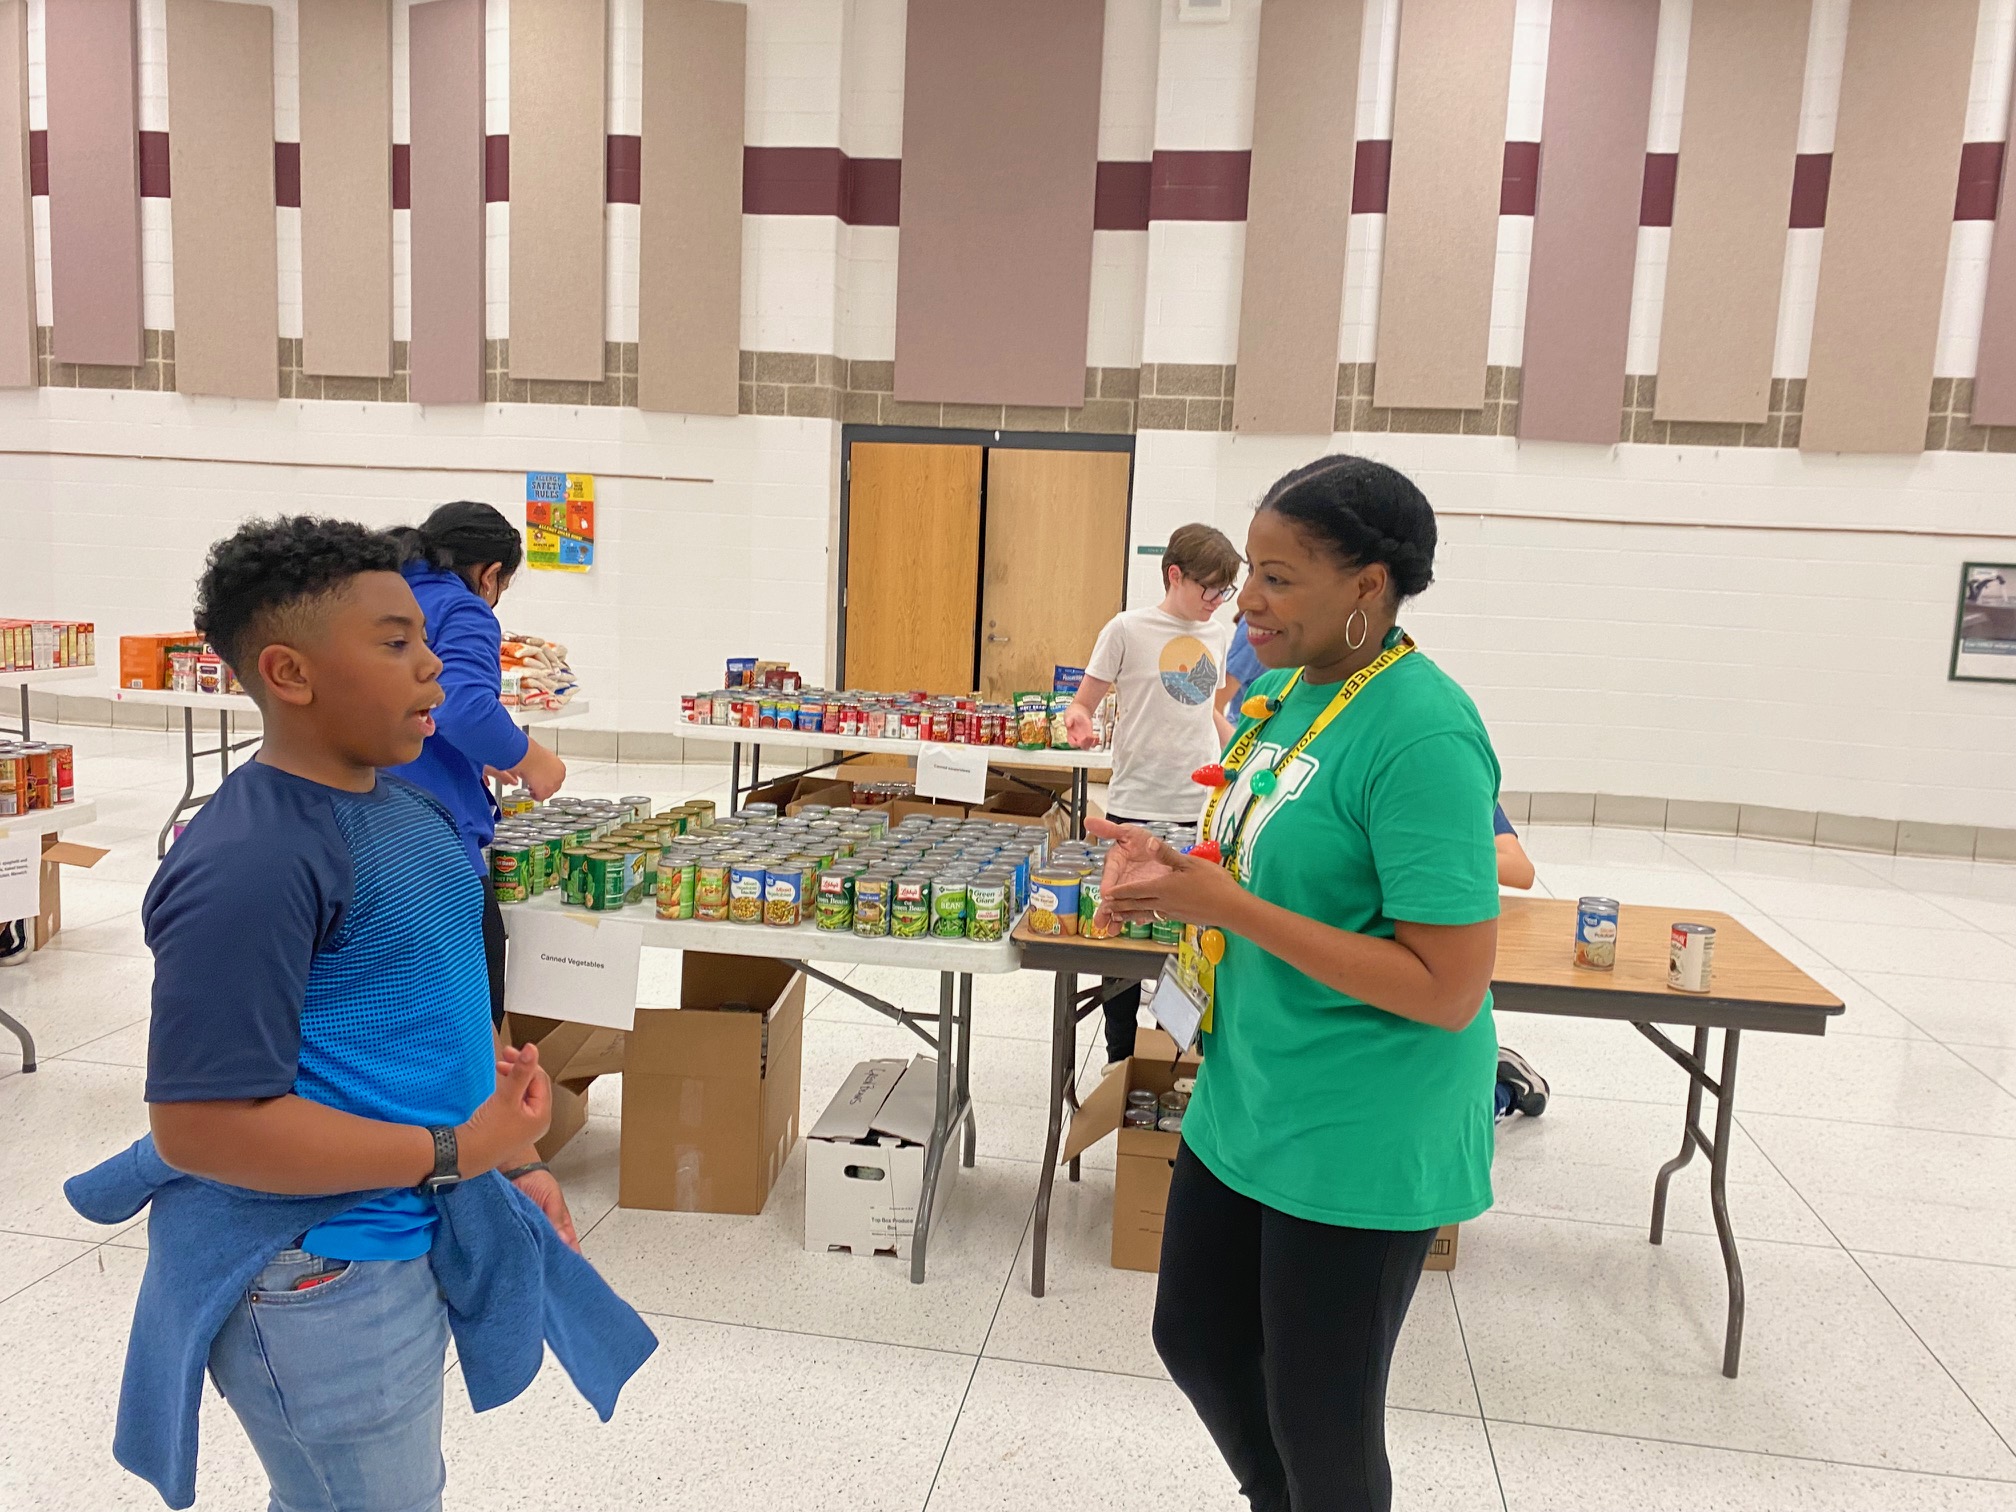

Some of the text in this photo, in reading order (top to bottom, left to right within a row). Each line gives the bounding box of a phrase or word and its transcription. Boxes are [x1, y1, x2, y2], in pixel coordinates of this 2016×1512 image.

[531, 481, 562, 491] SAFETY
[535, 490, 560, 499] RULES
[1341, 645, 1406, 700] OLUNTEER
[1274, 731, 1317, 778] VOLUN
[1203, 799, 1217, 841] TEER
[900, 887, 918, 896] Libby's
[973, 889, 995, 898] Green
[940, 901, 964, 910] BEANS
[540, 953, 605, 969] Canned Vegetables
